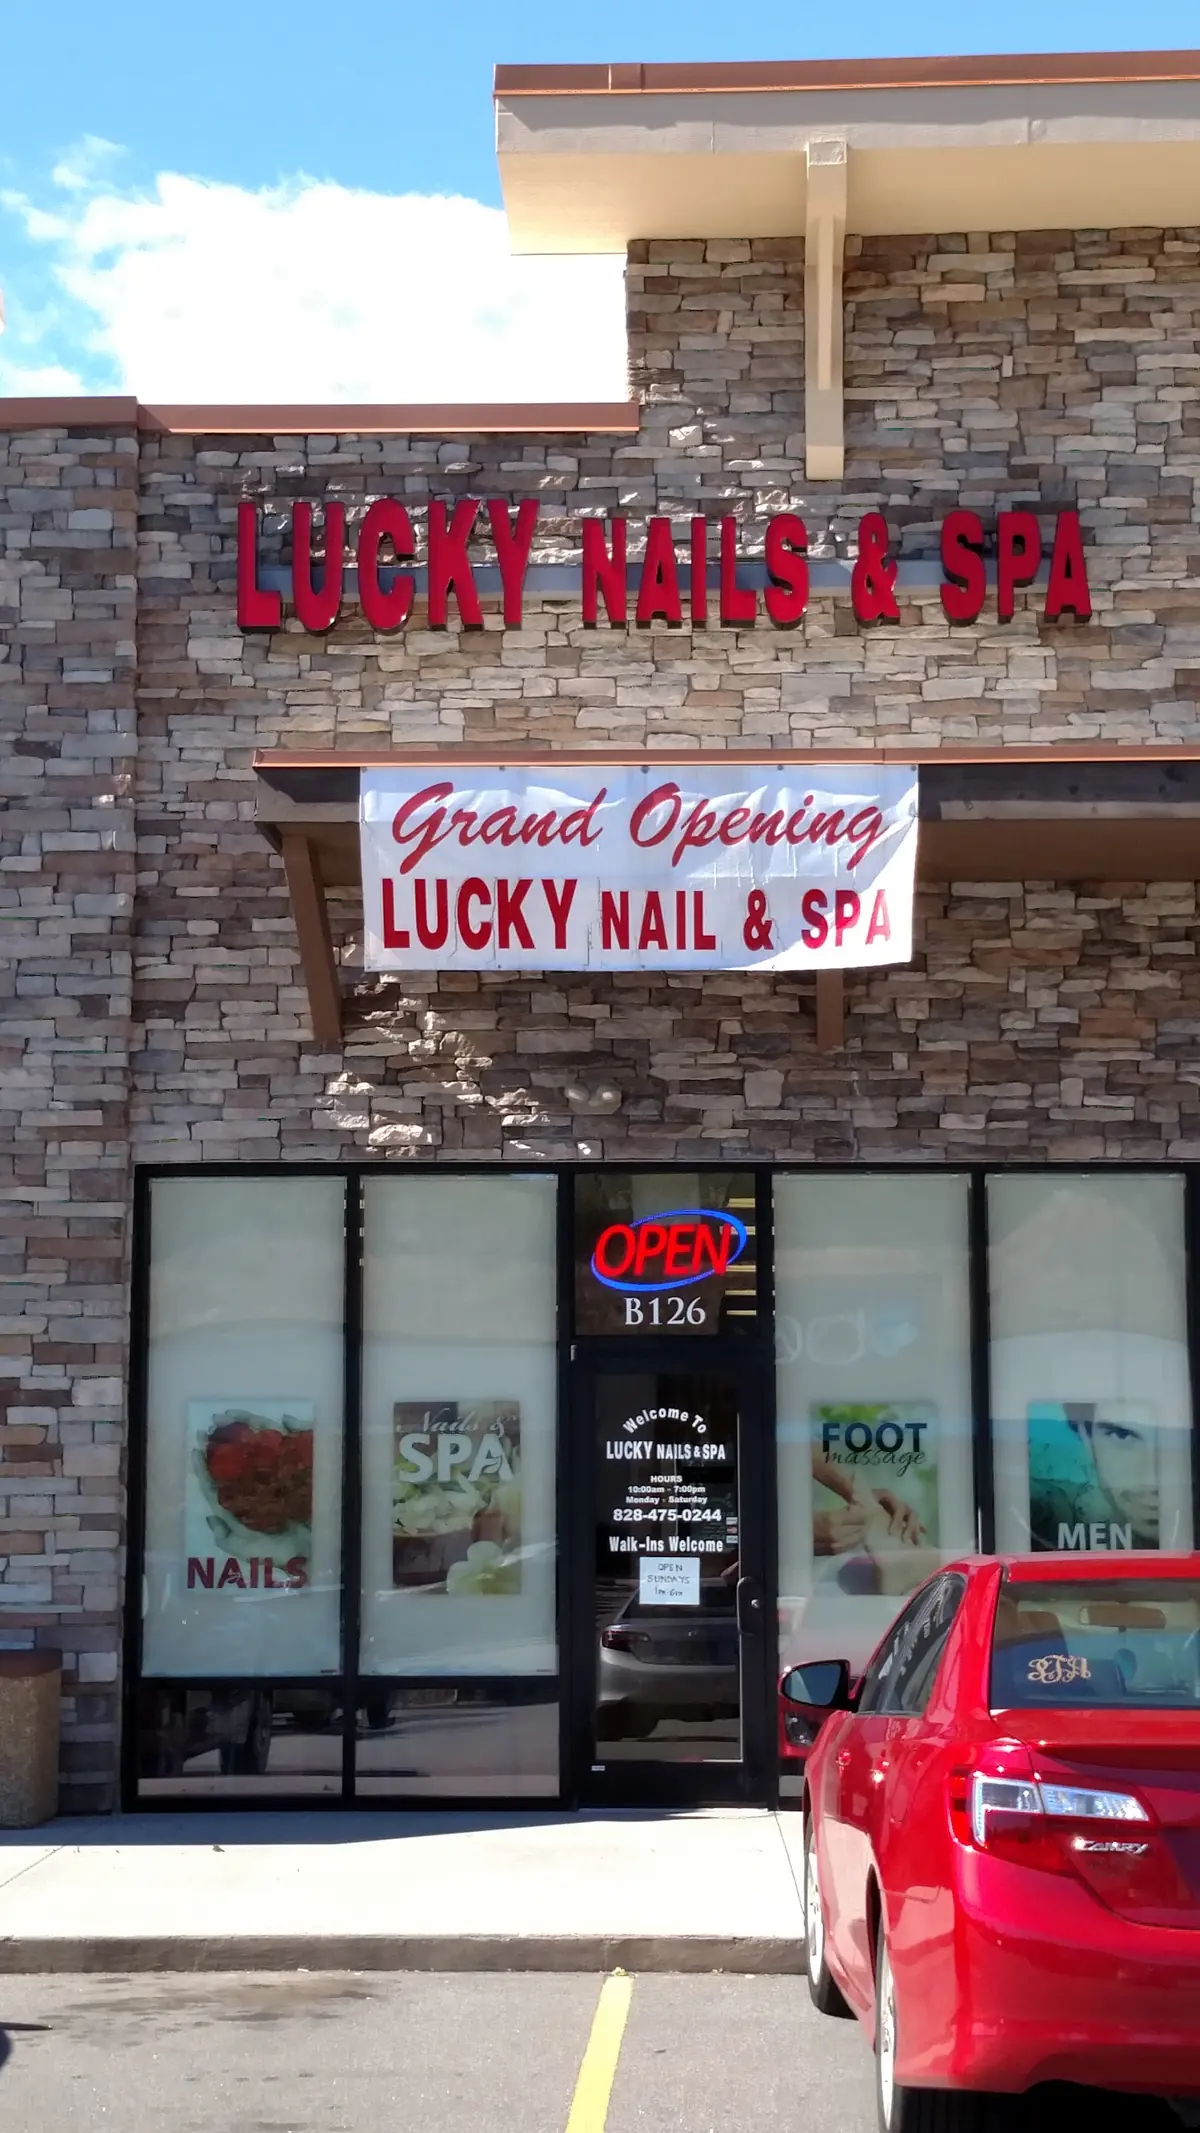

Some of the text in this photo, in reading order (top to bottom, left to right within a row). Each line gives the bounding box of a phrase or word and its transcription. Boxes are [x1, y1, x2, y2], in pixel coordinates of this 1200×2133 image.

[237, 498, 1092, 635] LUCKY NAILS & SPA
[392, 781, 886, 874] Grand Opening
[382, 877, 891, 951] LUCKY NAIL & SPA
[595, 1224, 731, 1277] OPEN
[624, 1296, 706, 1325] B126
[396, 1408, 480, 1432] Nails
[622, 1407, 707, 1434] Welcome To
[606, 1441, 726, 1459] LUCKY NAILS & SPA
[822, 1422, 928, 1452] FOOT
[399, 1433, 515, 1483] SPA
[825, 1448, 926, 1477] massage
[650, 1475, 683, 1483] HOURS
[673, 1485, 706, 1494] 7:00pm
[625, 1496, 660, 1505] Monday
[668, 1496, 708, 1505] Saturday
[613, 1509, 722, 1521] 828-475-0244
[609, 1536, 664, 1552] Walk-Ins
[668, 1536, 723, 1552] Welcome
[1057, 1522, 1133, 1550] MEN
[187, 1556, 308, 1589] NAILS
[647, 1574, 690, 1584] SUNDAYS
[657, 1563, 683, 1572] OPEN
